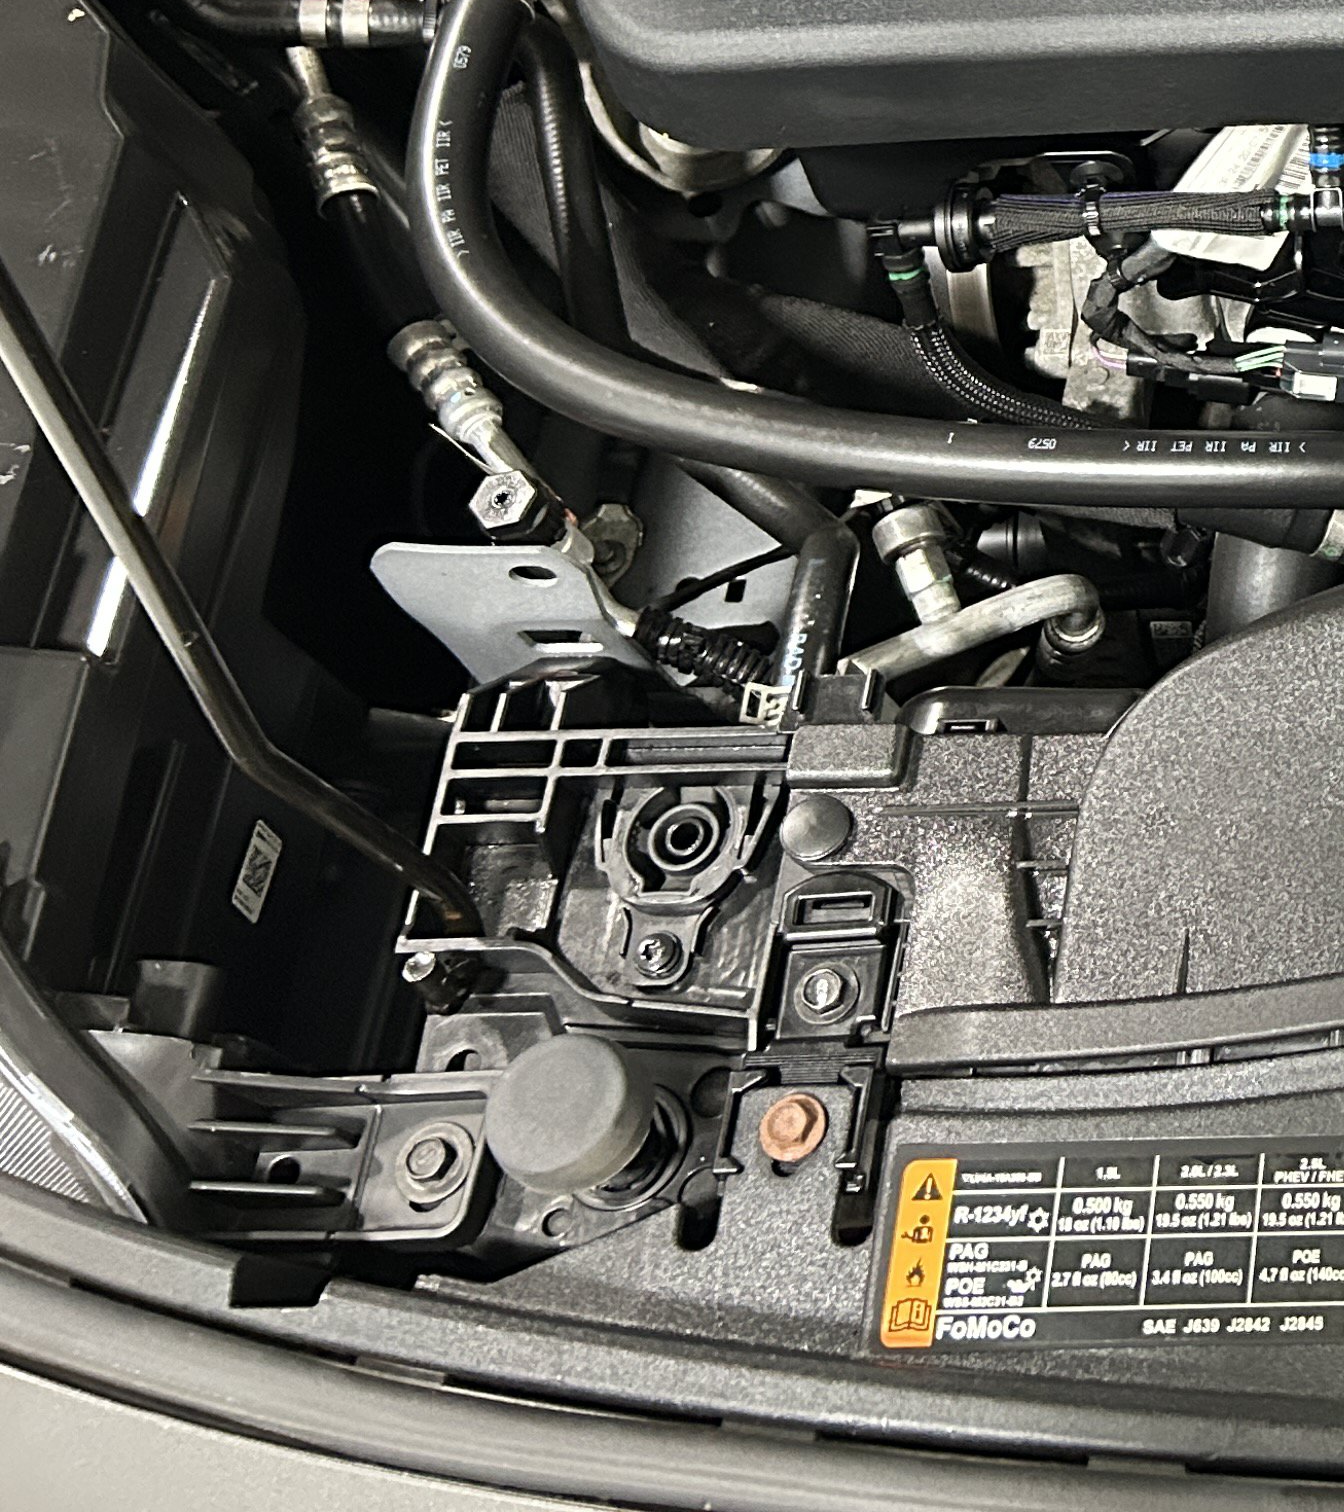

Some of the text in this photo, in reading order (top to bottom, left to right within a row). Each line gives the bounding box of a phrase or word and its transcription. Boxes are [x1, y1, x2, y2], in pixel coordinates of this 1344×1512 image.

[453, 44, 472, 70] 0579
[434, 157, 450, 177] PET
[1027, 437, 1056, 449] 0579
[1169, 440, 1193, 451] PET
[1274, 1171, 1309, 1183] PHEV
[1114, 1197, 1133, 1216] kg
[1175, 1193, 1234, 1211] 0.550 kg
[1281, 1192, 1341, 1211] 0.550 kg
[954, 1204, 1028, 1226] R-1234yf
[1182, 1215, 1196, 1227] oz
[1289, 1214, 1303, 1226] oz
[1073, 1218, 1089, 1231] oz
[949, 1243, 989, 1260] PAG
[1184, 1251, 1214, 1267] PAG
[1292, 1250, 1320, 1263] POE
[1081, 1253, 1112, 1268] PAG
[1052, 1272, 1070, 1287] 2.7
[1082, 1272, 1098, 1286] oz
[1183, 1271, 1198, 1284] oz
[1259, 1269, 1278, 1283] 4.7
[1290, 1269, 1305, 1282] oz
[945, 1277, 986, 1295] POE
[935, 1315, 1037, 1340] FoMoCo
[1142, 1316, 1324, 1335] SAE J639 J2842 J2845
